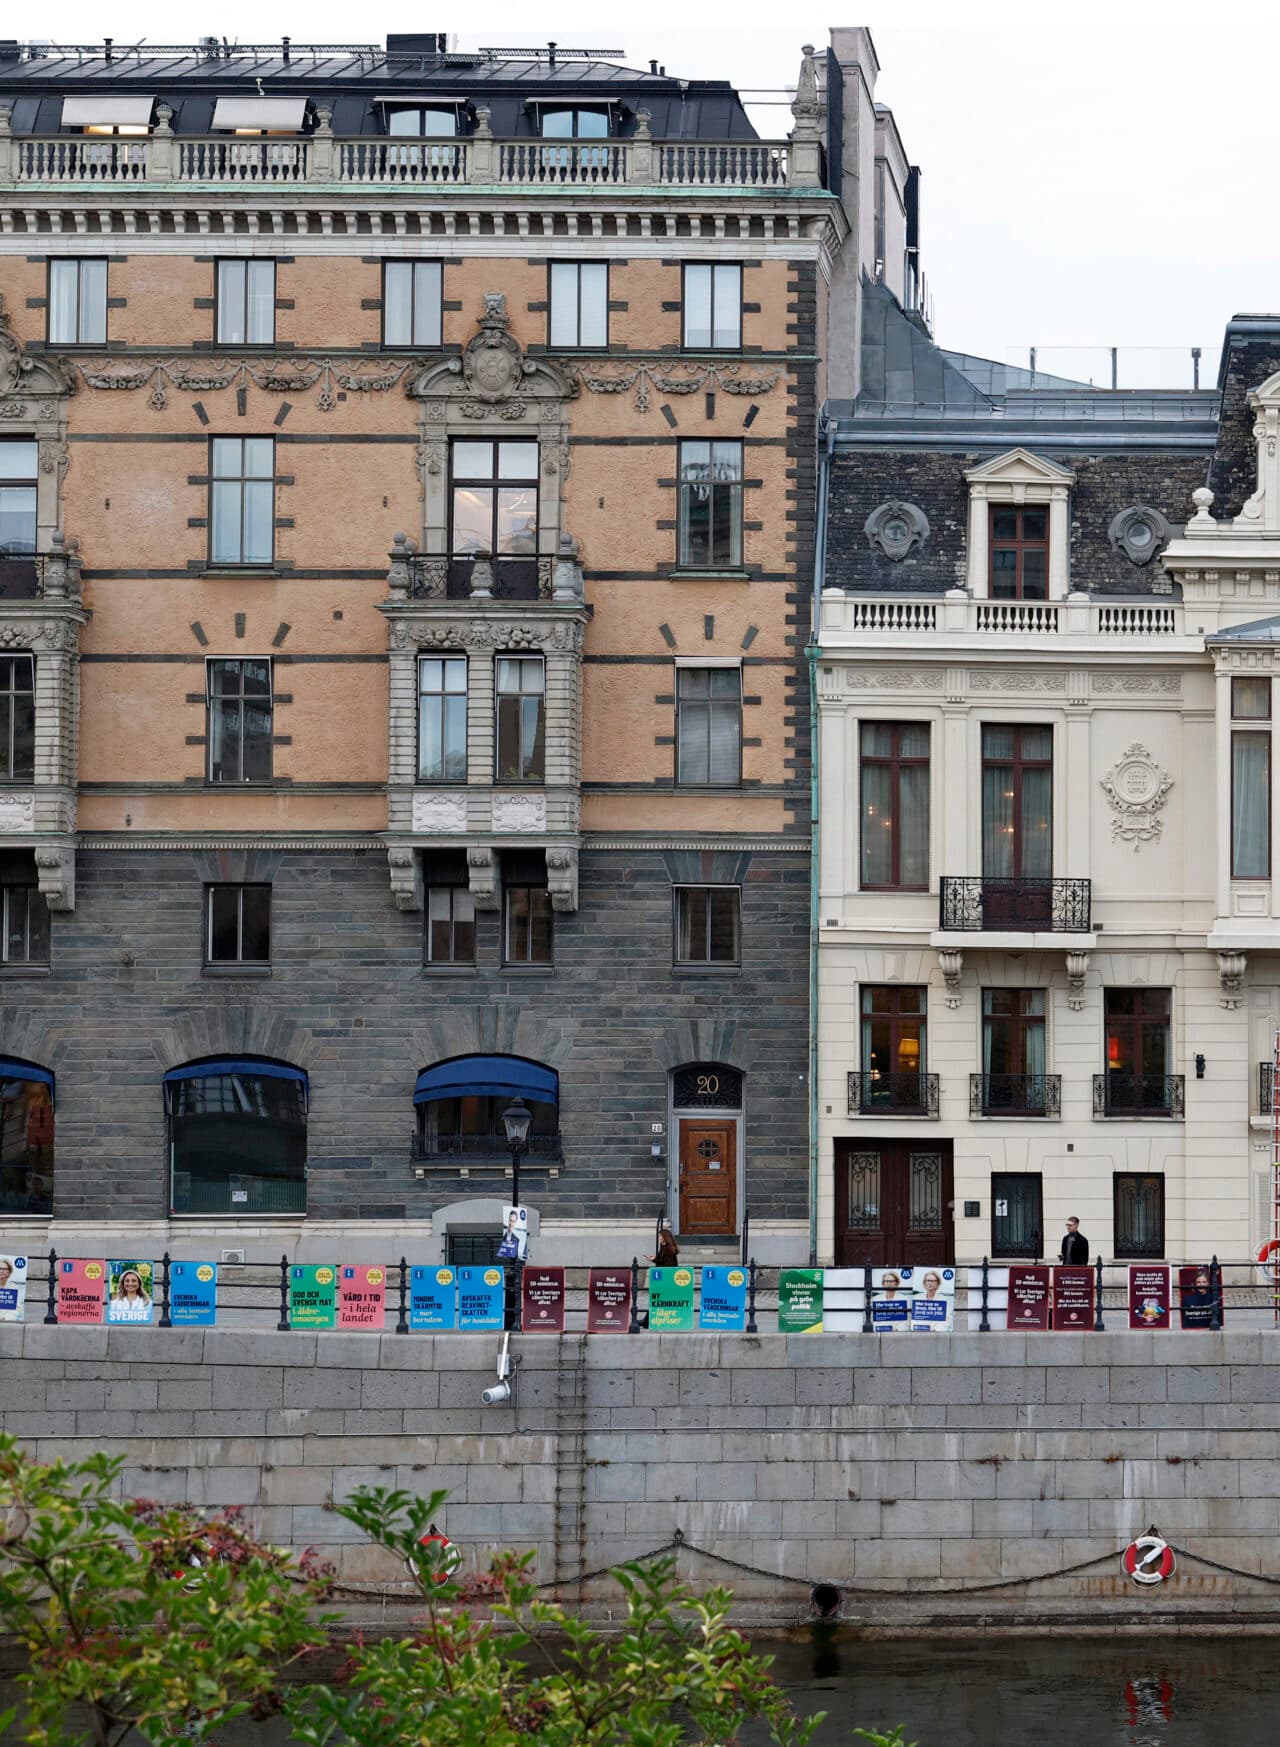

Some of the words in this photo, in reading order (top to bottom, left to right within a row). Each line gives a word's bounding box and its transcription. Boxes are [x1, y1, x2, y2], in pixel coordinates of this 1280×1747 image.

[697, 1075, 719, 1094] 20
[653, 1124, 662, 1132] 20
[61, 1294, 100, 1302] VÅRDKÖERNA
[343, 1292, 362, 1302] VÅRD
[364, 1294, 367, 1302] I
[369, 1294, 381, 1302] TID
[357, 1303, 376, 1313] hela
[60, 1310, 99, 1318] regionerna
[110, 1311, 149, 1320] SVERIGE
[342, 1313, 373, 1322] landet
